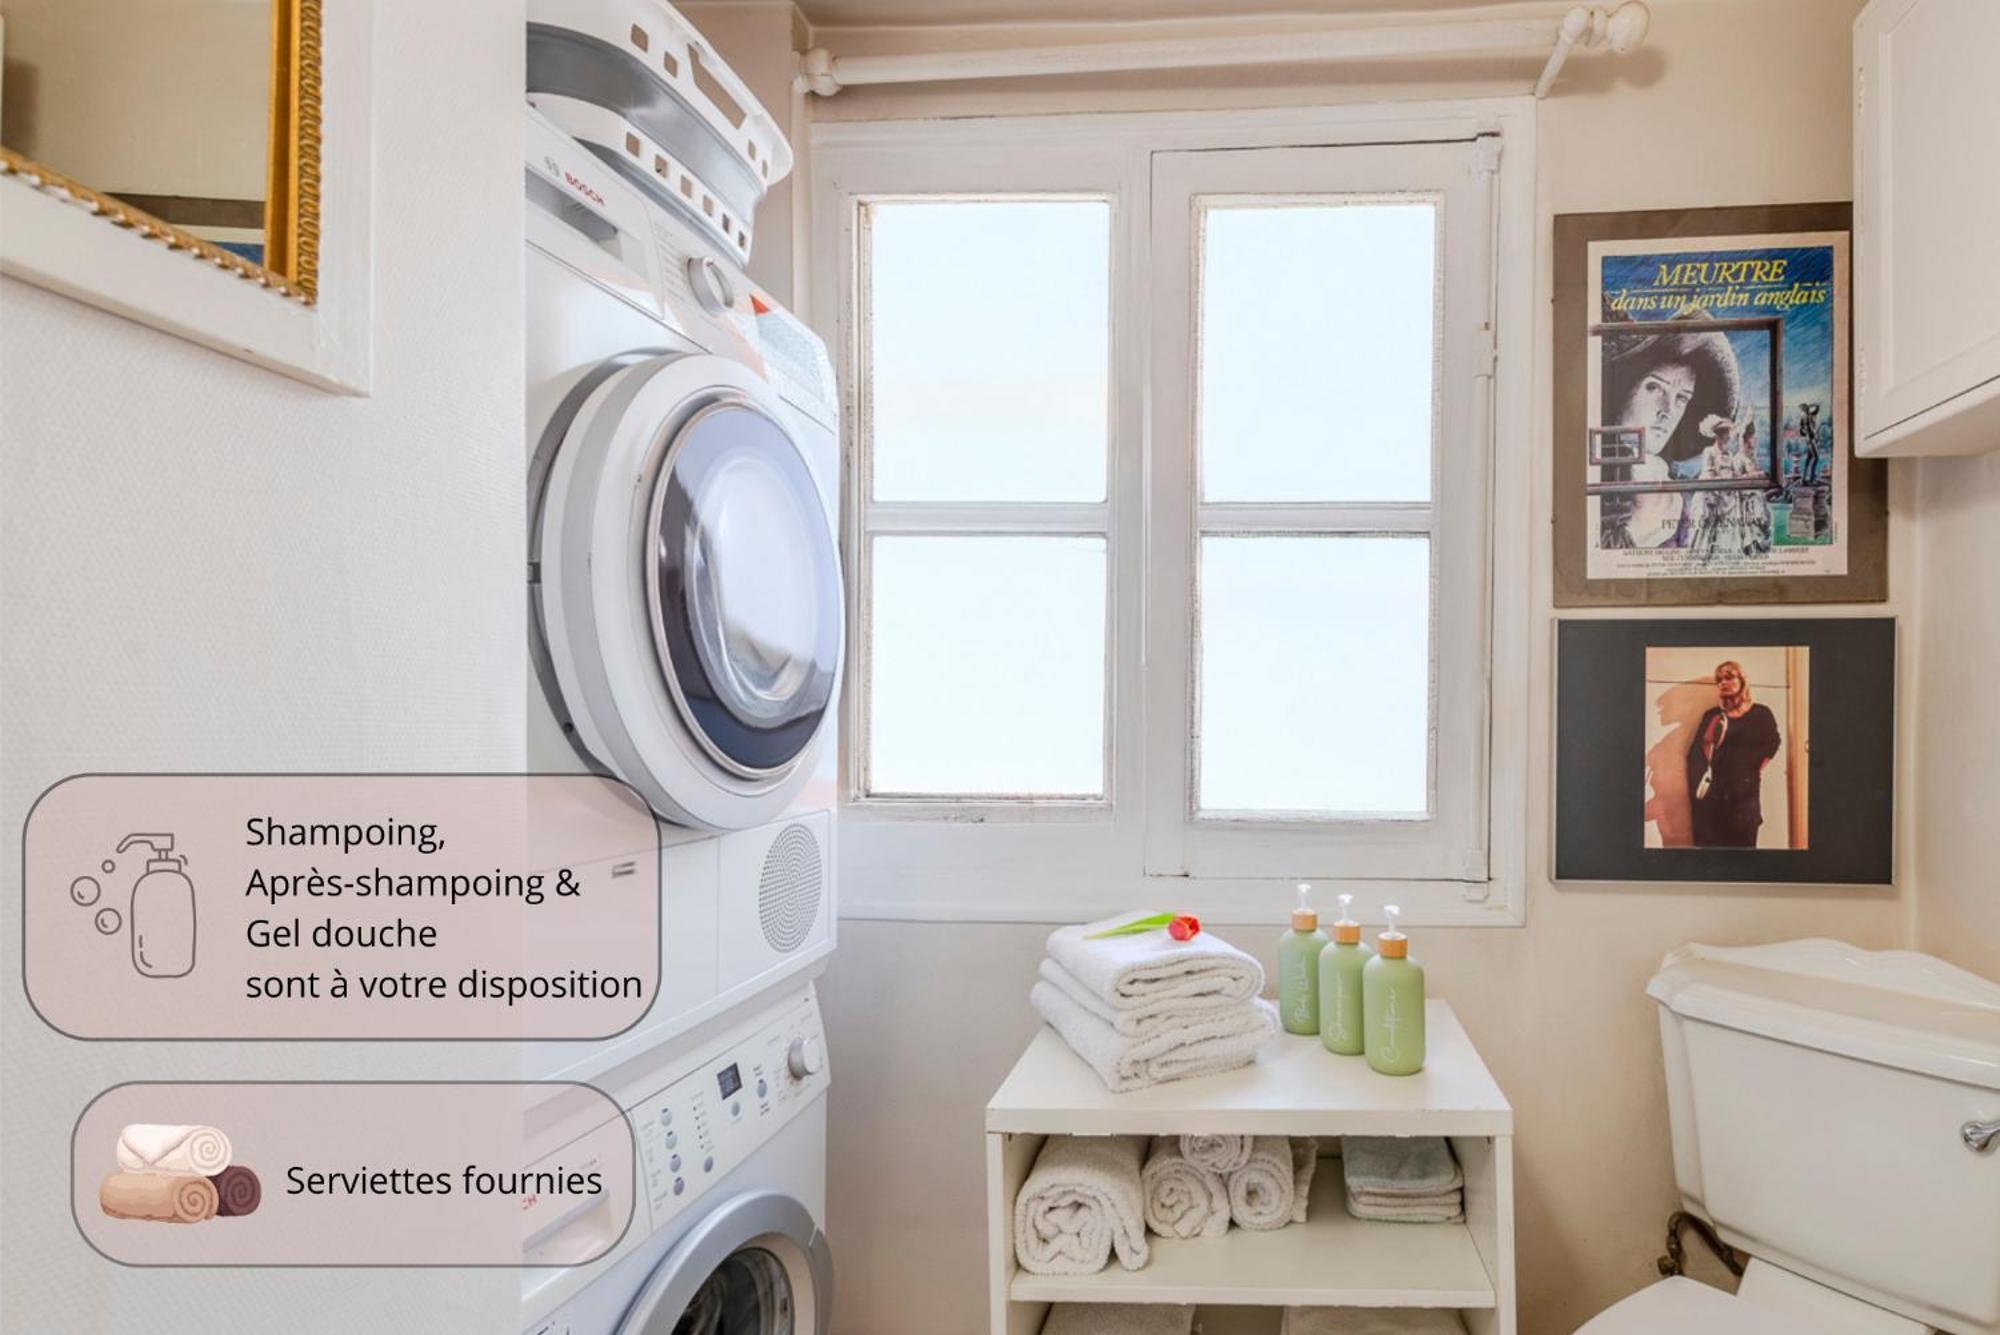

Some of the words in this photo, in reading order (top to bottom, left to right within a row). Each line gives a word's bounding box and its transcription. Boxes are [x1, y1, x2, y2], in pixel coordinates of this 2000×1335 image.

[565, 171, 605, 206] BOSCH
[1653, 259, 1787, 286] MEURTRE
[1610, 288, 1657, 311] dans
[1660, 296, 1686, 310] un
[1682, 285, 1750, 315] jardin
[1751, 282, 1826, 311] anglais
